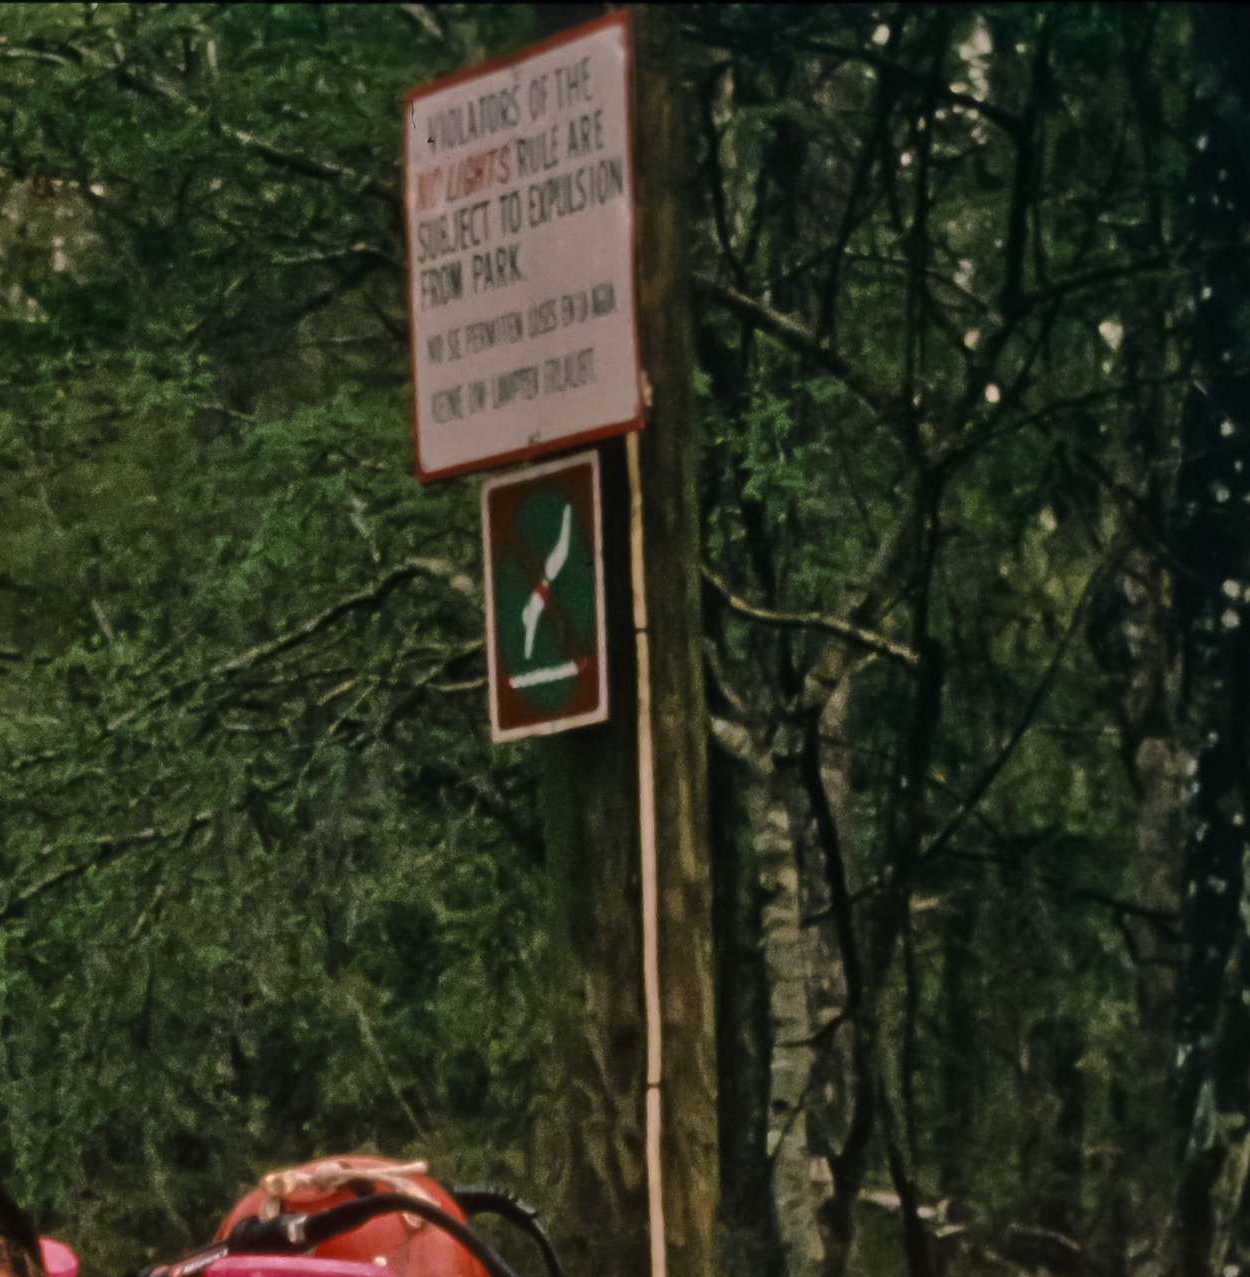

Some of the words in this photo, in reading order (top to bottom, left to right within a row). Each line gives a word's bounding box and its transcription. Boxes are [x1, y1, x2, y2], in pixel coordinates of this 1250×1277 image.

[427, 83, 520, 153] VIOLATORS
[528, 73, 548, 121] OF
[554, 56, 593, 109] THE
[446, 144, 511, 203] LIGHTS
[516, 124, 559, 178] RULE
[568, 109, 604, 154] ARE
[418, 200, 490, 263] SUBJECT
[499, 190, 522, 235] TO
[528, 155, 624, 229] EXPULSION
[420, 260, 463, 311] FROM
